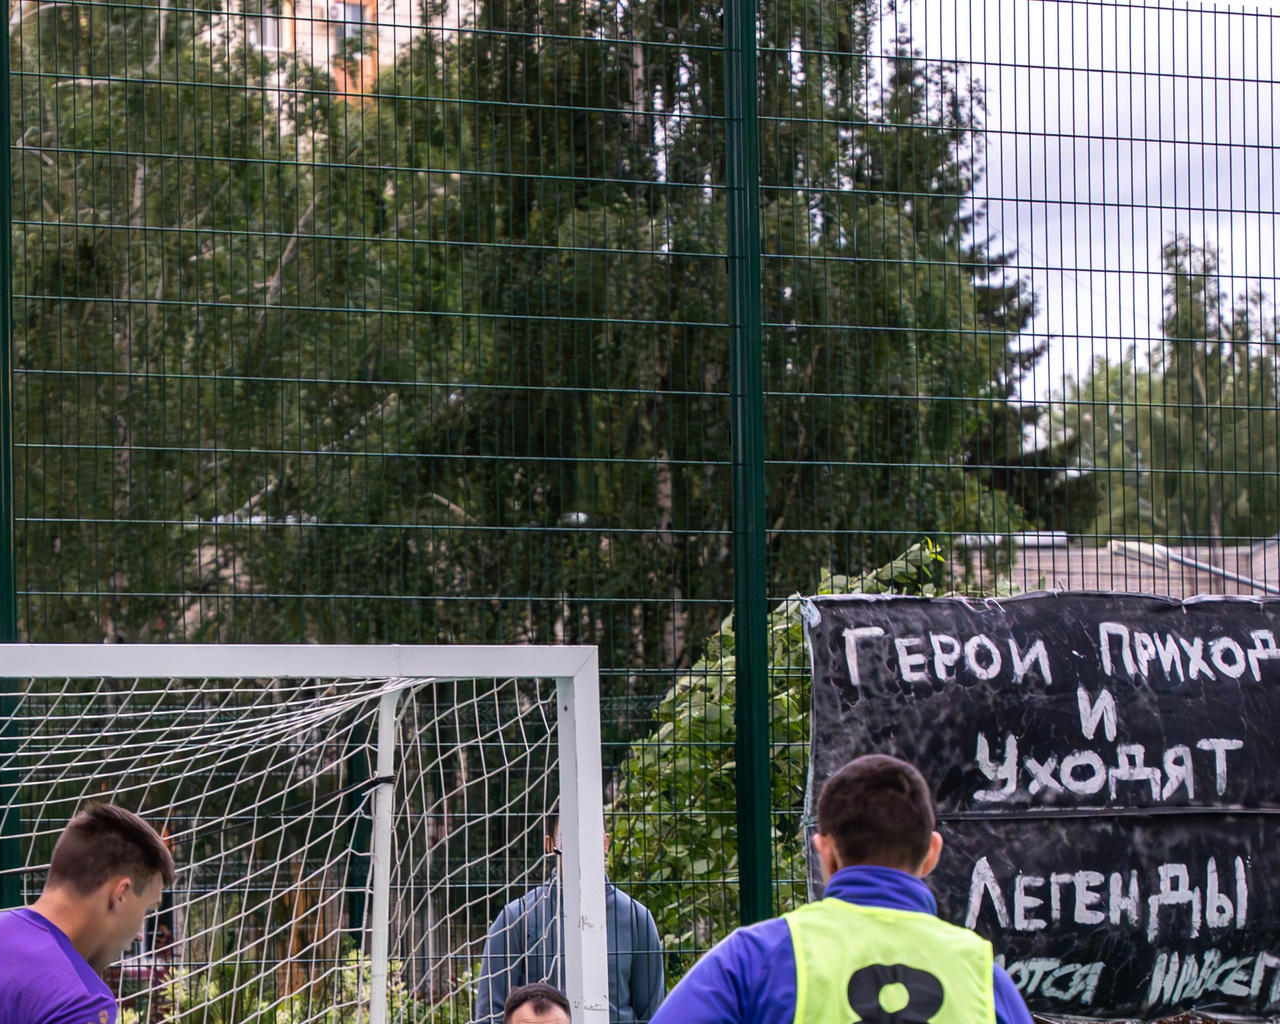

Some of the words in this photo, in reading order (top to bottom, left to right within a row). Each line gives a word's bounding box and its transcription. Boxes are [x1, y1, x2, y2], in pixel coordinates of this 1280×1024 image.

[841, 626, 1053, 686] ГЕРОИ
[1077, 687, 1118, 742] И
[973, 731, 1244, 802] УХОДЯТ
[966, 856, 1248, 943] ЛЕГЕНДЫ
